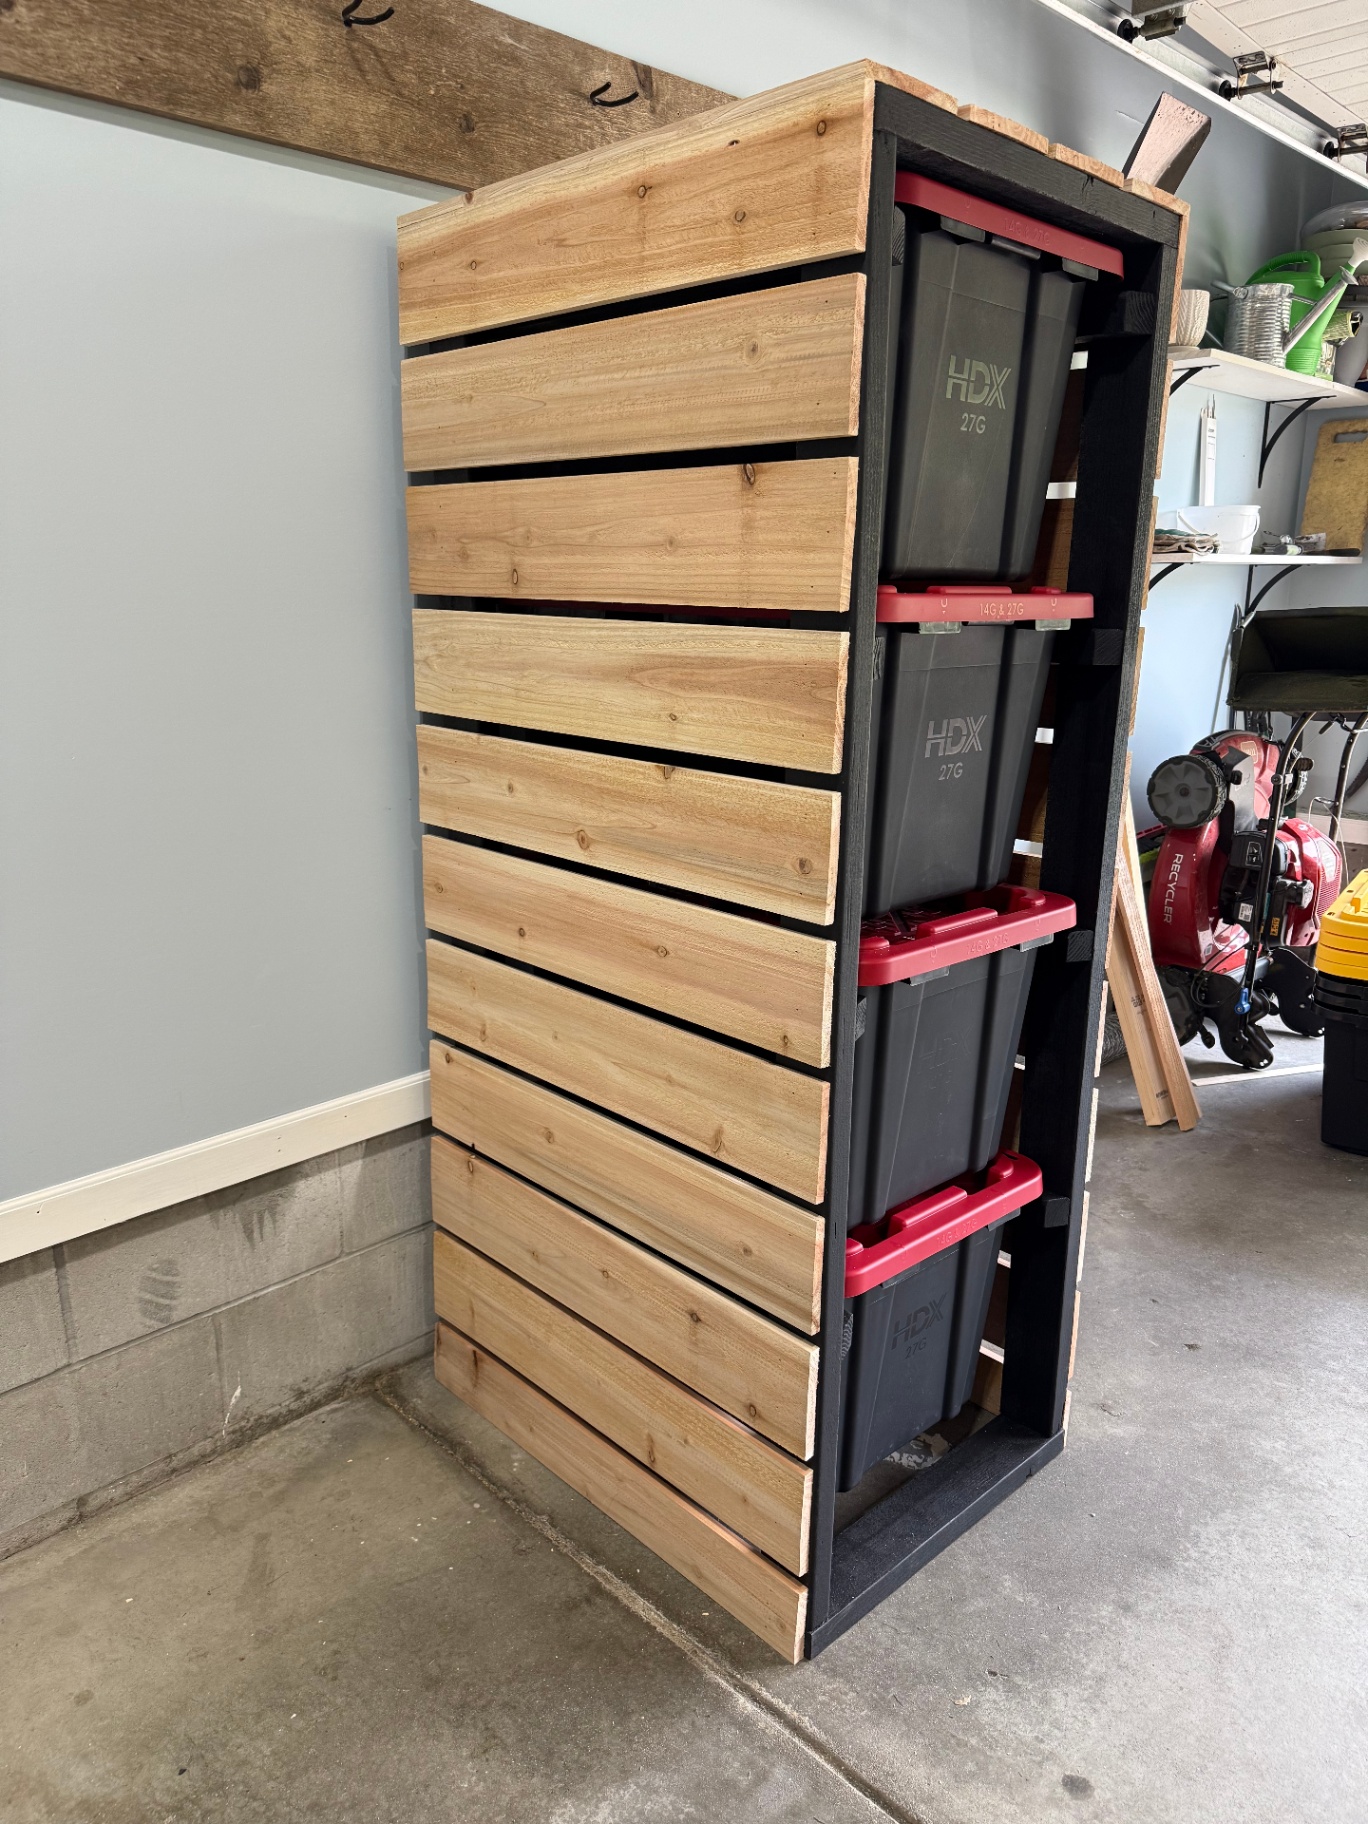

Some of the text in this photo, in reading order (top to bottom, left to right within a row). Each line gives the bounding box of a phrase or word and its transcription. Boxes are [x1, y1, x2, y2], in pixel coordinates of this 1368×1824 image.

[945, 354, 1012, 410] HDX
[960, 412, 986, 434] 27G
[979, 602, 1024, 616] 14G & 27G
[924, 714, 987, 758] HDX
[938, 762, 964, 781] 27G
[1163, 853, 1184, 926] RECYCLER
[891, 1292, 948, 1350] HDX
[905, 1337, 927, 1359] 27G
